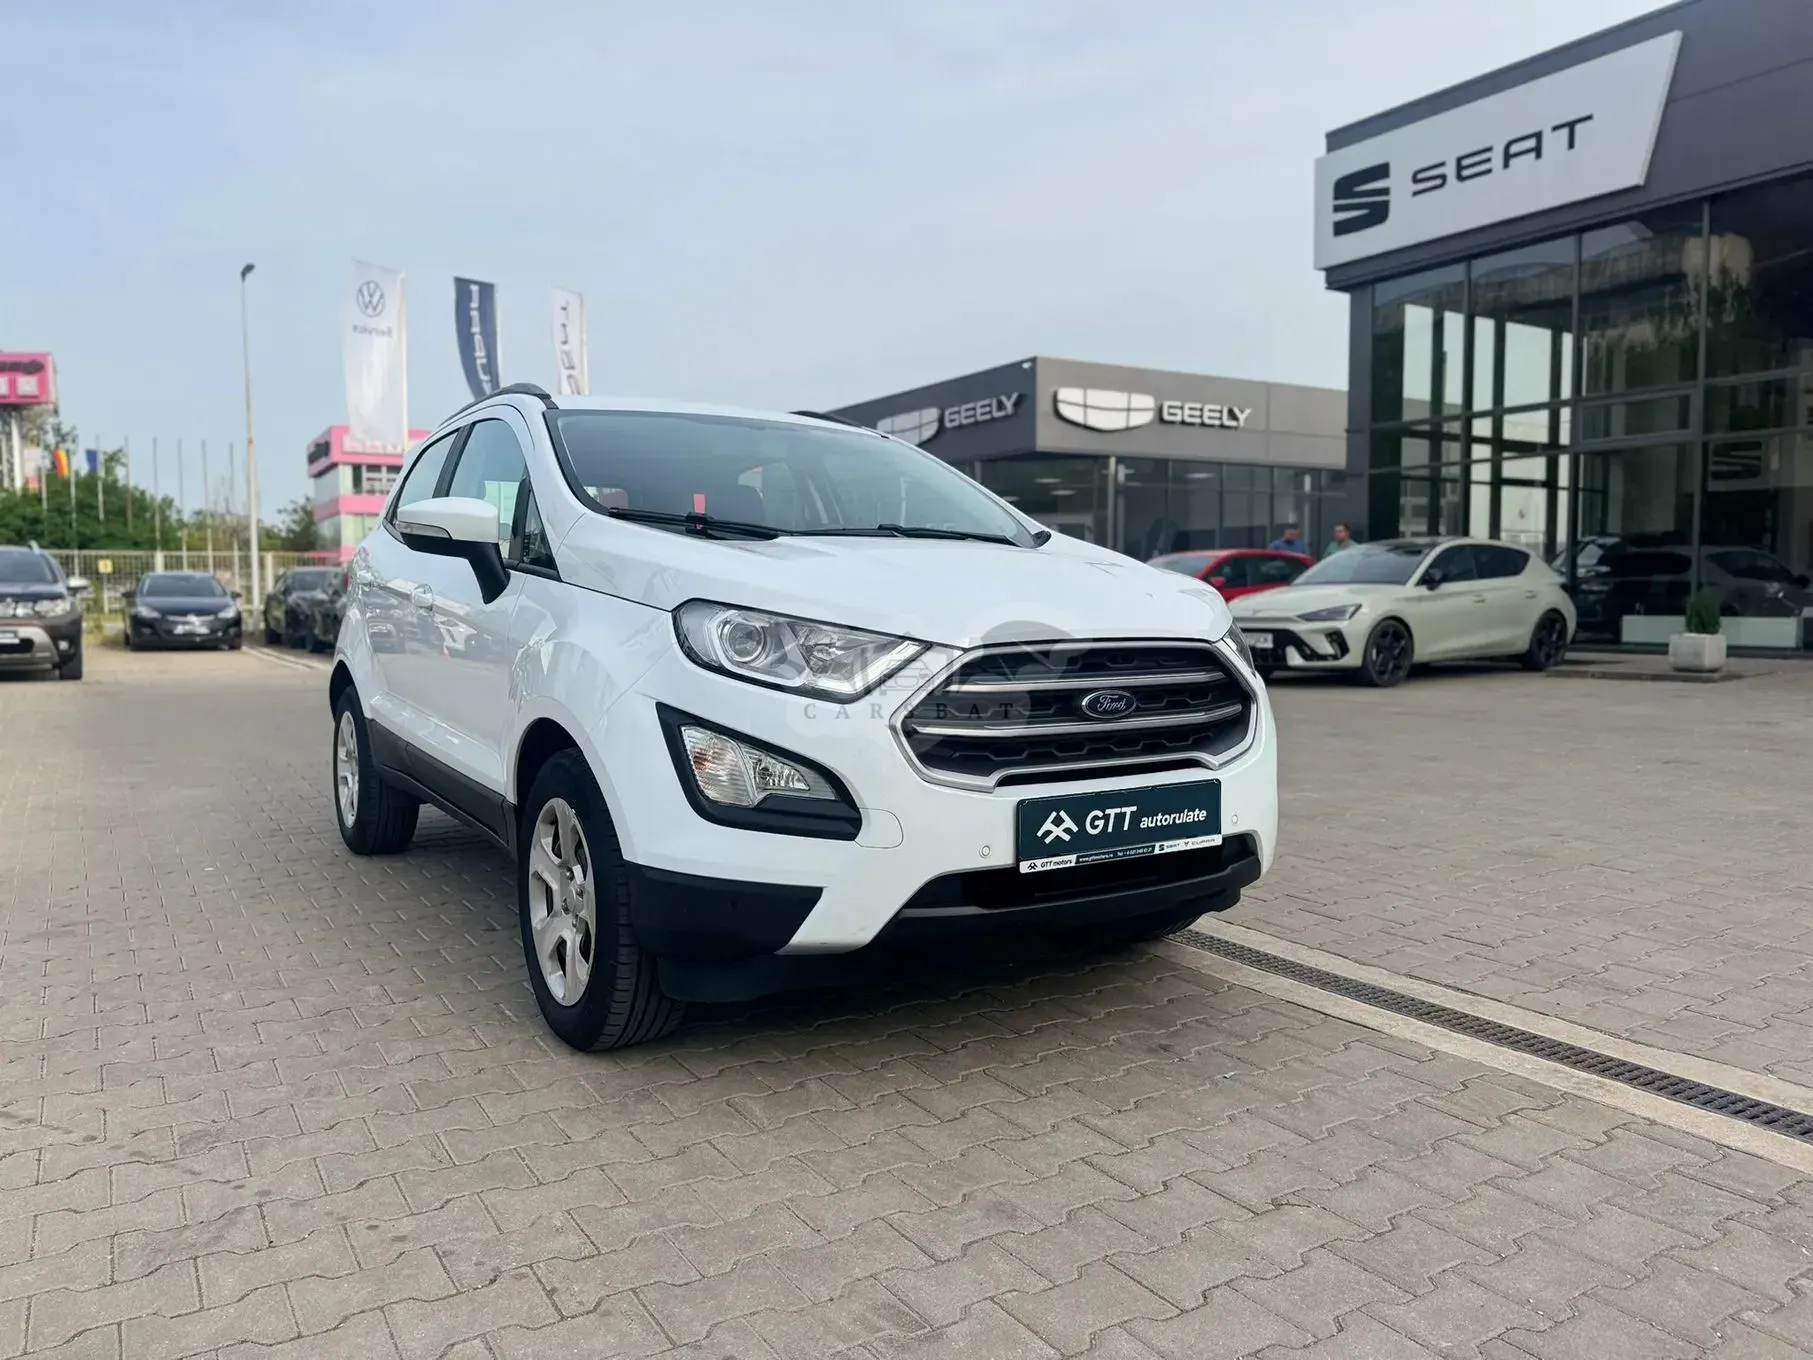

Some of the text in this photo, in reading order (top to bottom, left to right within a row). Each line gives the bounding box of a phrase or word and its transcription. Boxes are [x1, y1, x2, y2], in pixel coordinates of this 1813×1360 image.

[1411, 113, 1594, 198] SEAT
[943, 391, 1019, 429] GEELY
[1161, 400, 1252, 428] GEELY
[1097, 694, 1127, 712] Ford
[1085, 805, 1208, 835] GTT autorulate
[1040, 859, 1073, 869] GTT motors
